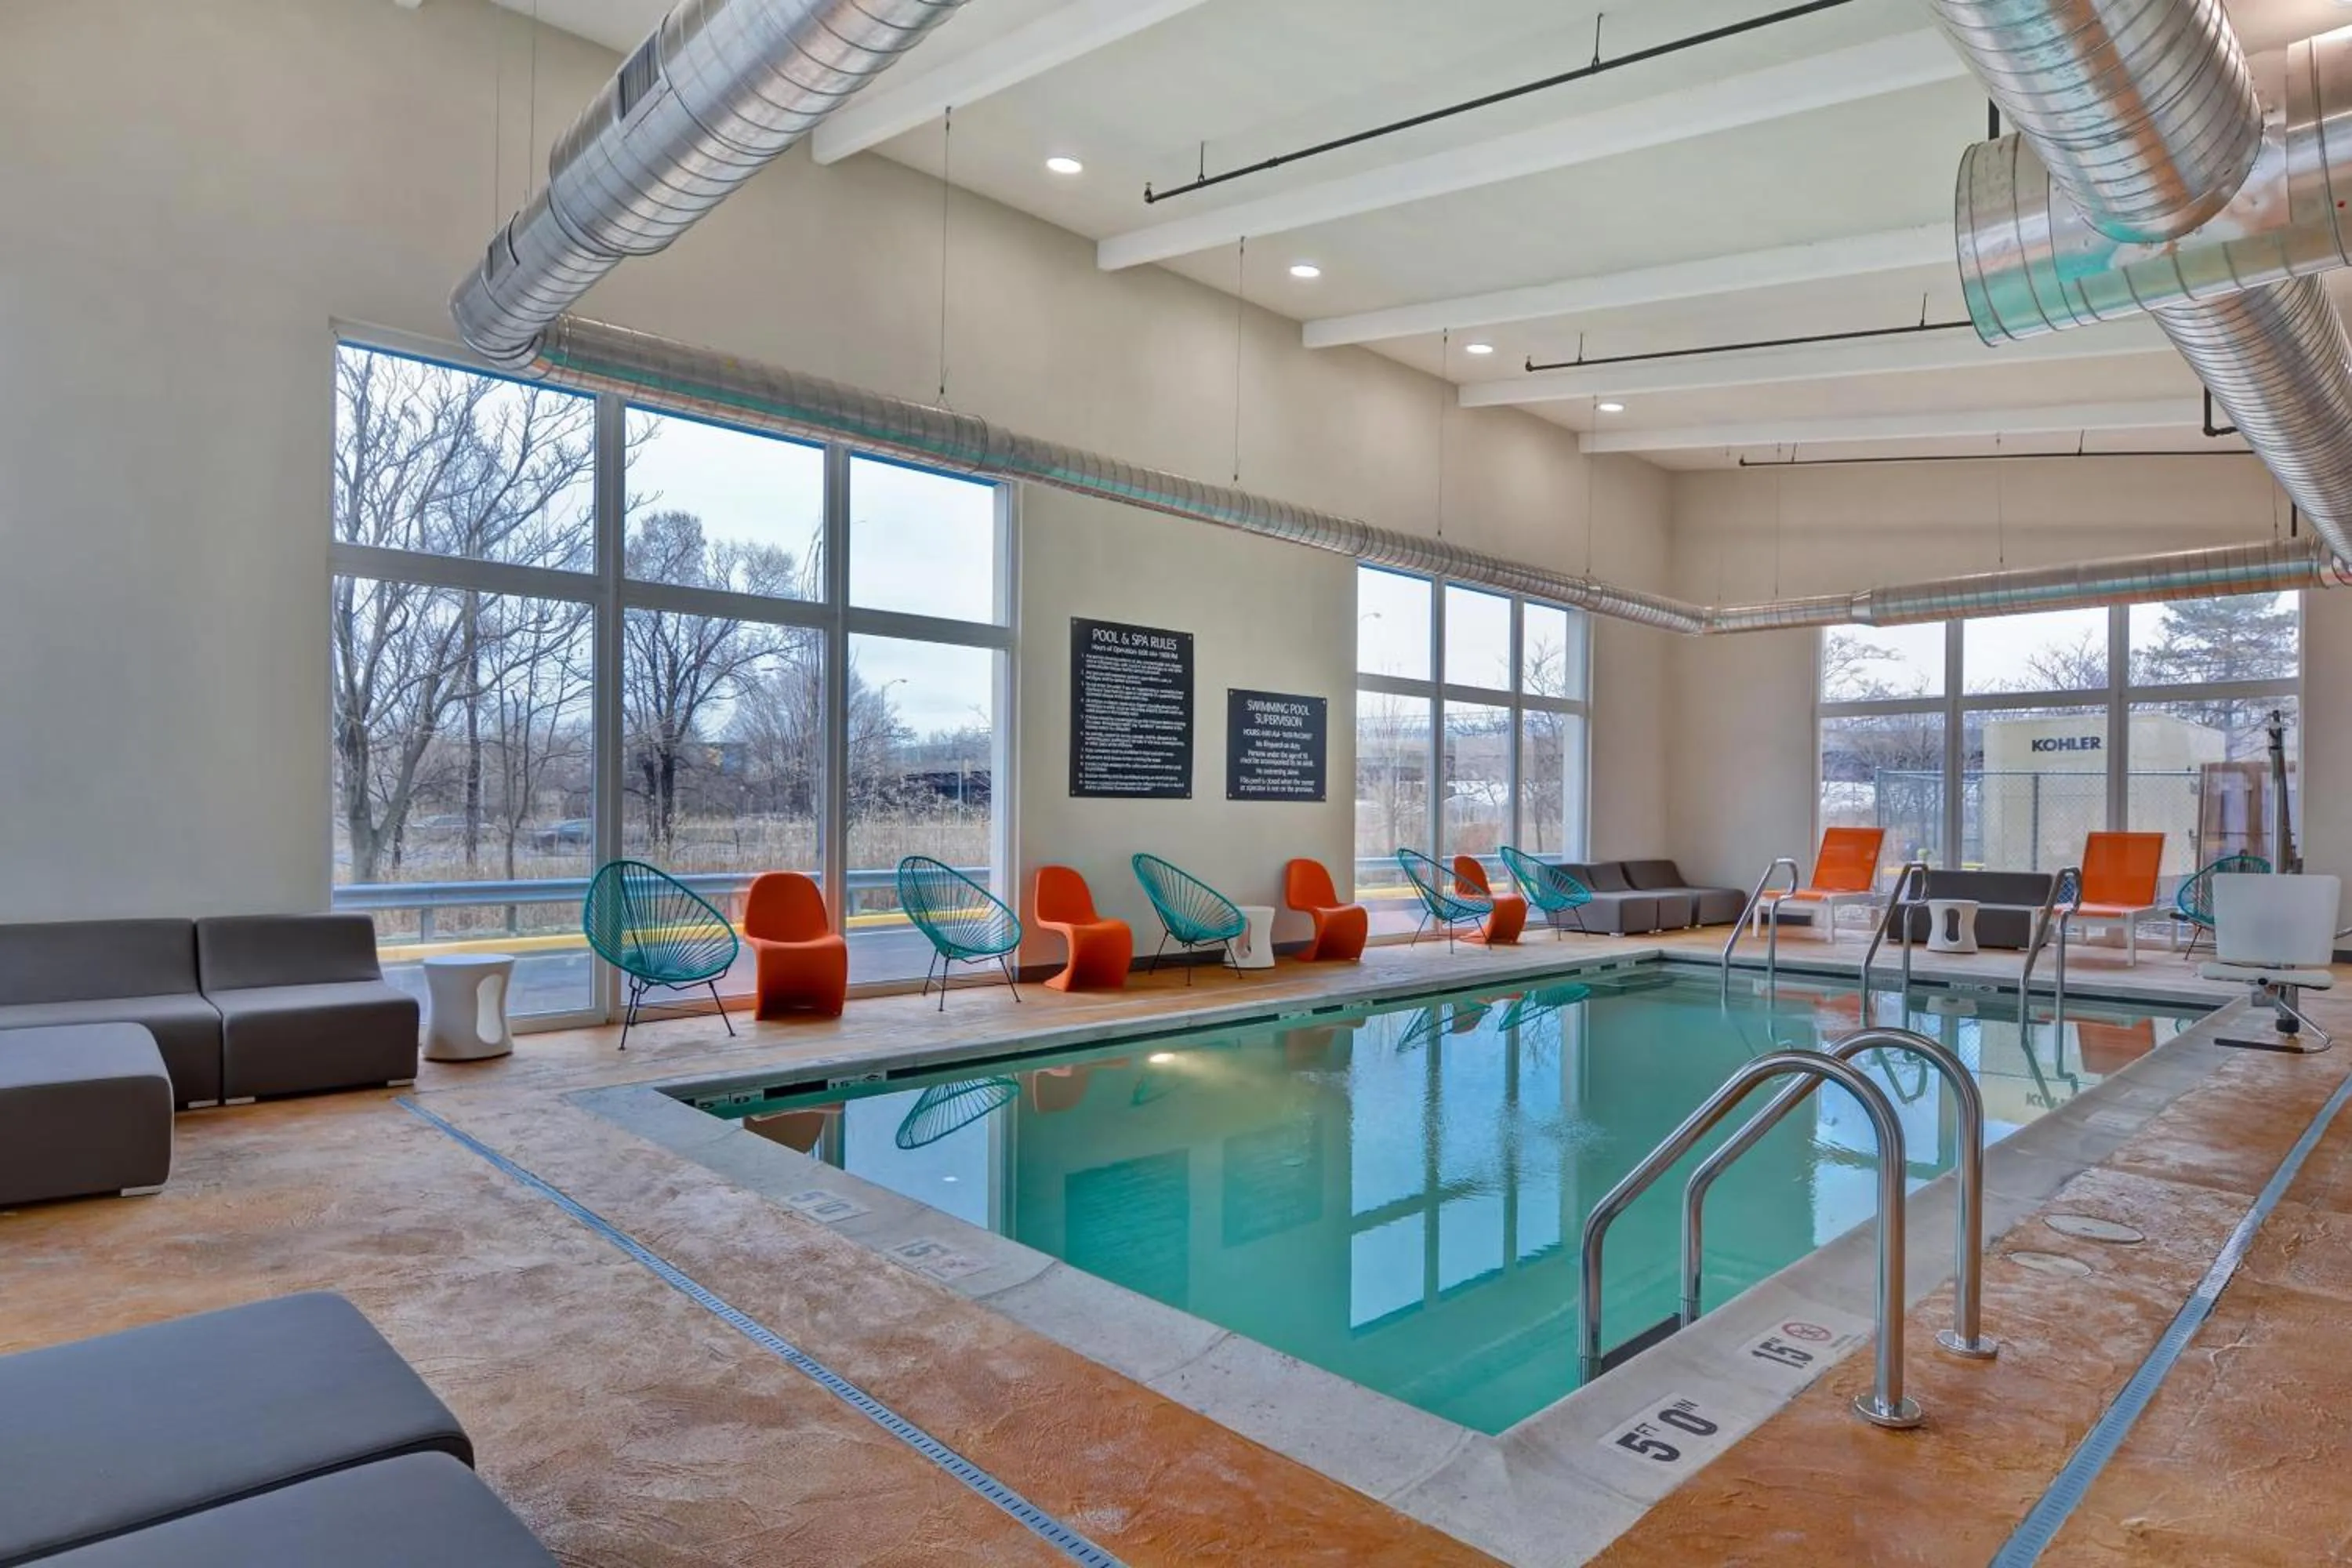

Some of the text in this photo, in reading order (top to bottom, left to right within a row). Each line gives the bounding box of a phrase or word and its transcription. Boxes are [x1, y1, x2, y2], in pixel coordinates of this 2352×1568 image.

[1092, 628, 1177, 651] POOL & SPA RULES
[1247, 699, 1310, 716] SWIMMING POOL
[1254, 713, 1302, 727] SUPERVISION
[2031, 736, 2102, 753] KOHLER
[1615, 1432, 1681, 1462] 5
[1657, 1409, 1719, 1436] 0
